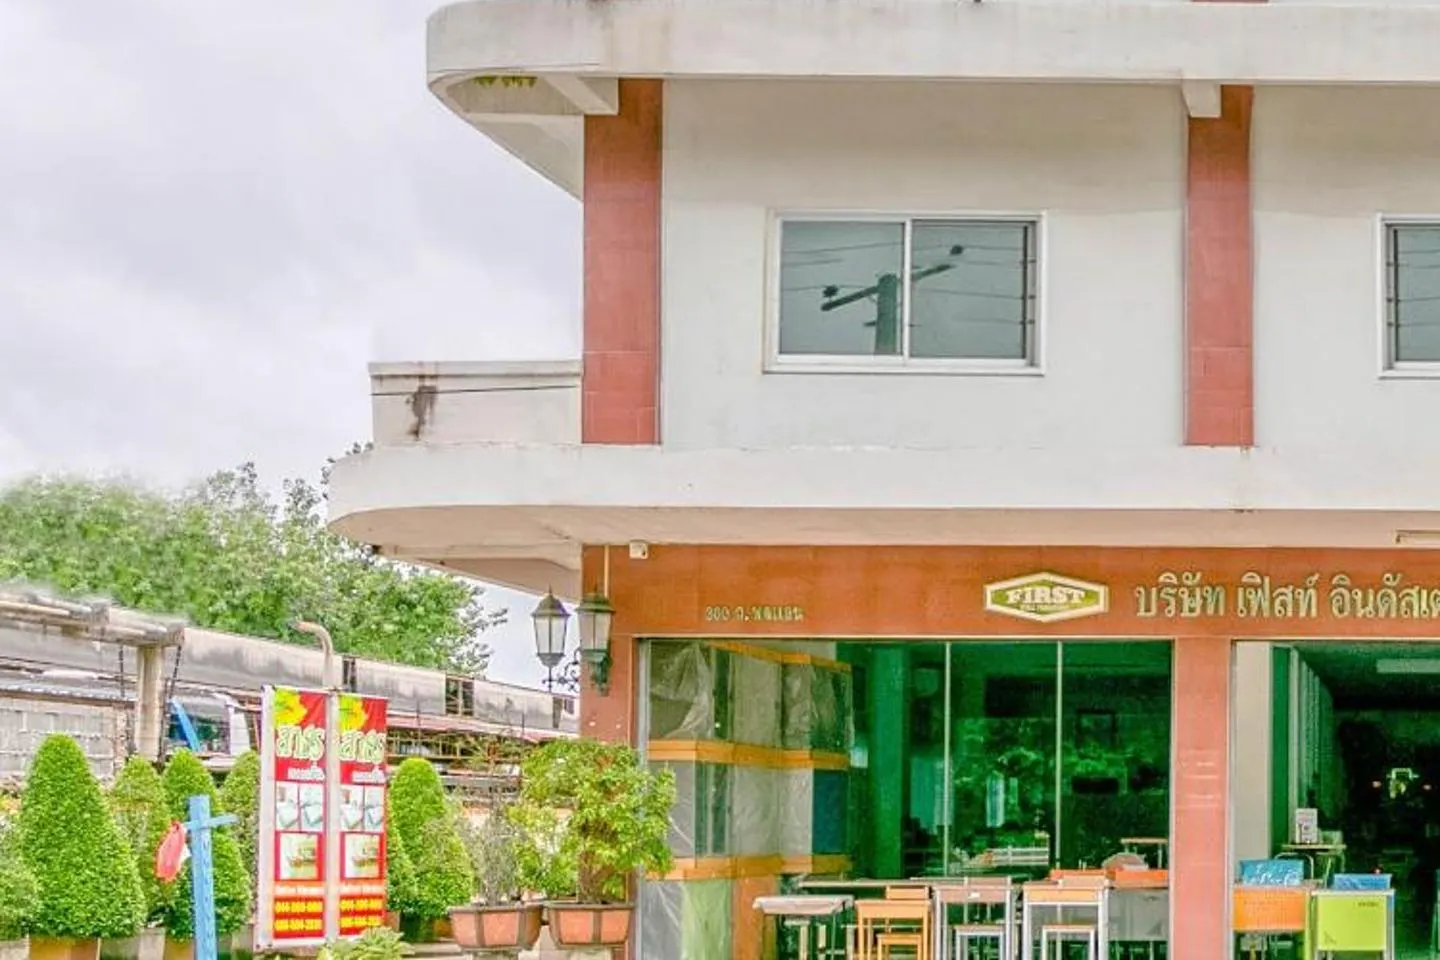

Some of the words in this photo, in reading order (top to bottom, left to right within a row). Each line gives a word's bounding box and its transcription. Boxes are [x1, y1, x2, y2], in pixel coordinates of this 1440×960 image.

[1005, 585, 1086, 604] FIRST
[1135, 571, 1227, 617] บริษัท
